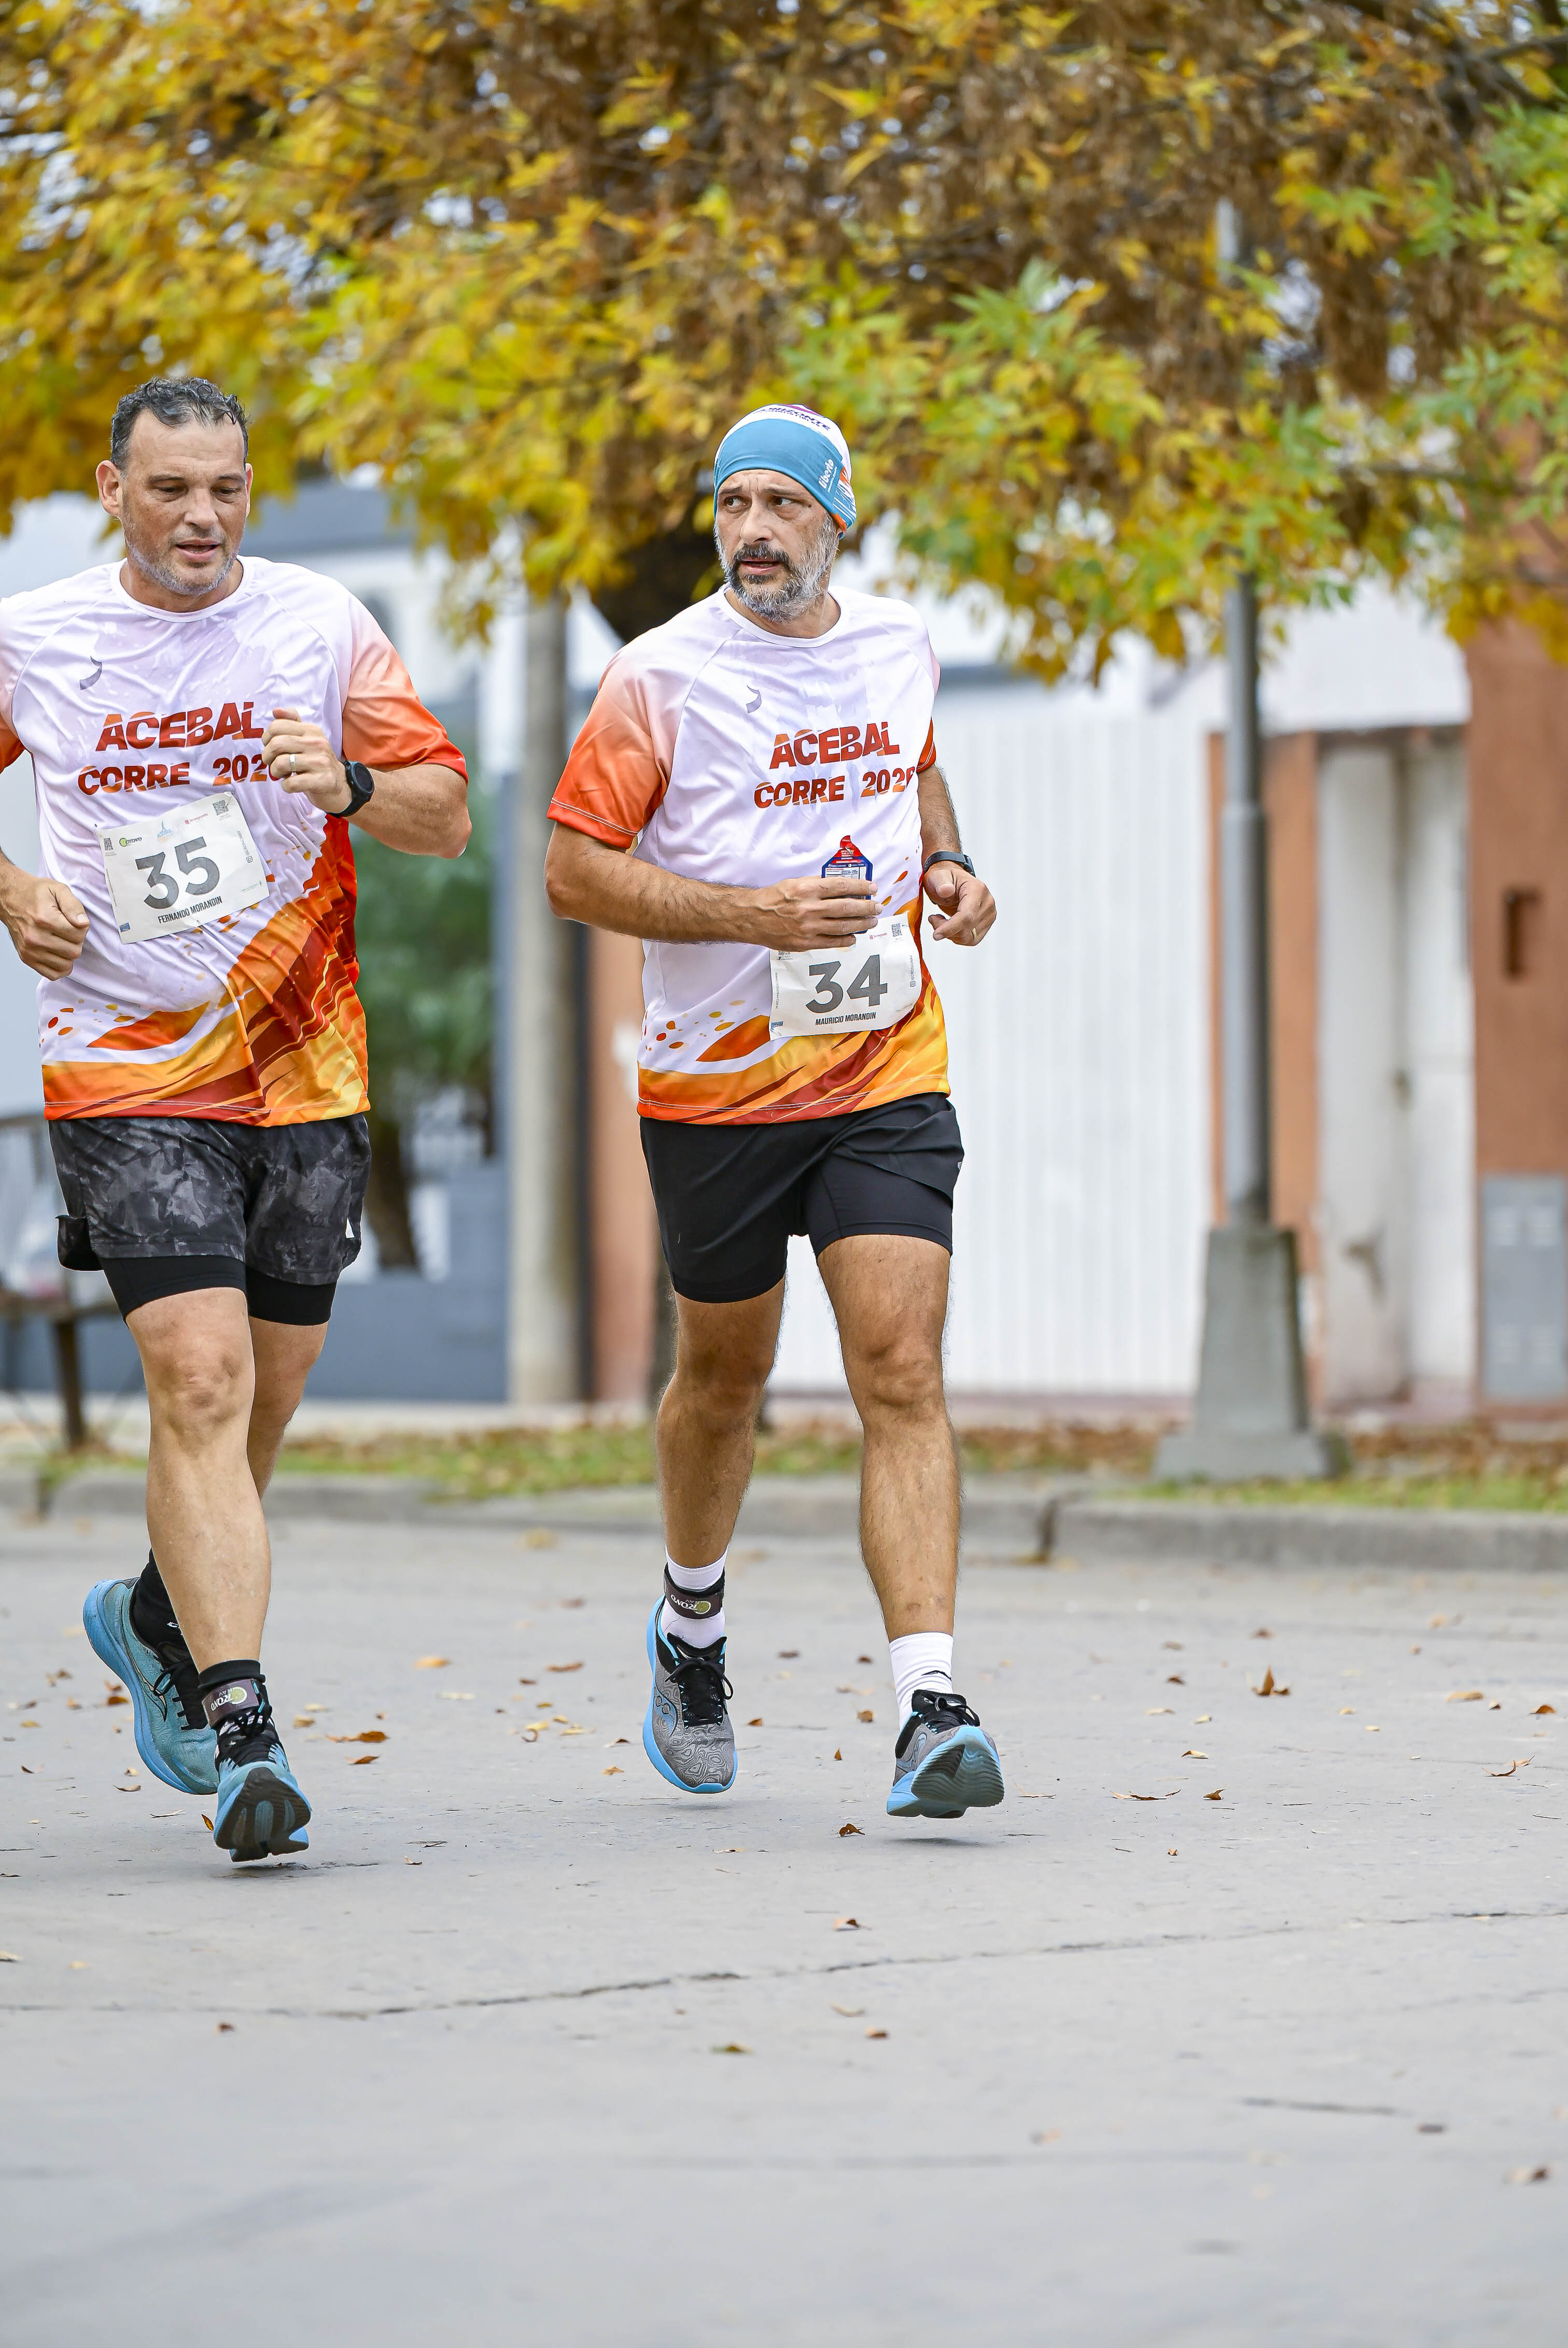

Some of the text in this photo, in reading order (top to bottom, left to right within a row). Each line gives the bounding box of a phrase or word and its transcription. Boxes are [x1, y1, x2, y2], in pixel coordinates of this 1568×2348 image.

[95, 702, 263, 751] ACEBAL
[769, 721, 900, 769] ACEBAL
[78, 753, 282, 796] CORRE 202
[754, 775, 845, 808] CORRE
[135, 836, 220, 910] 35
[158, 896, 222, 924] FERNANDO MORANDIN
[805, 954, 888, 1014] 34
[815, 1012, 876, 1026] MAURICIO MORANDIN
